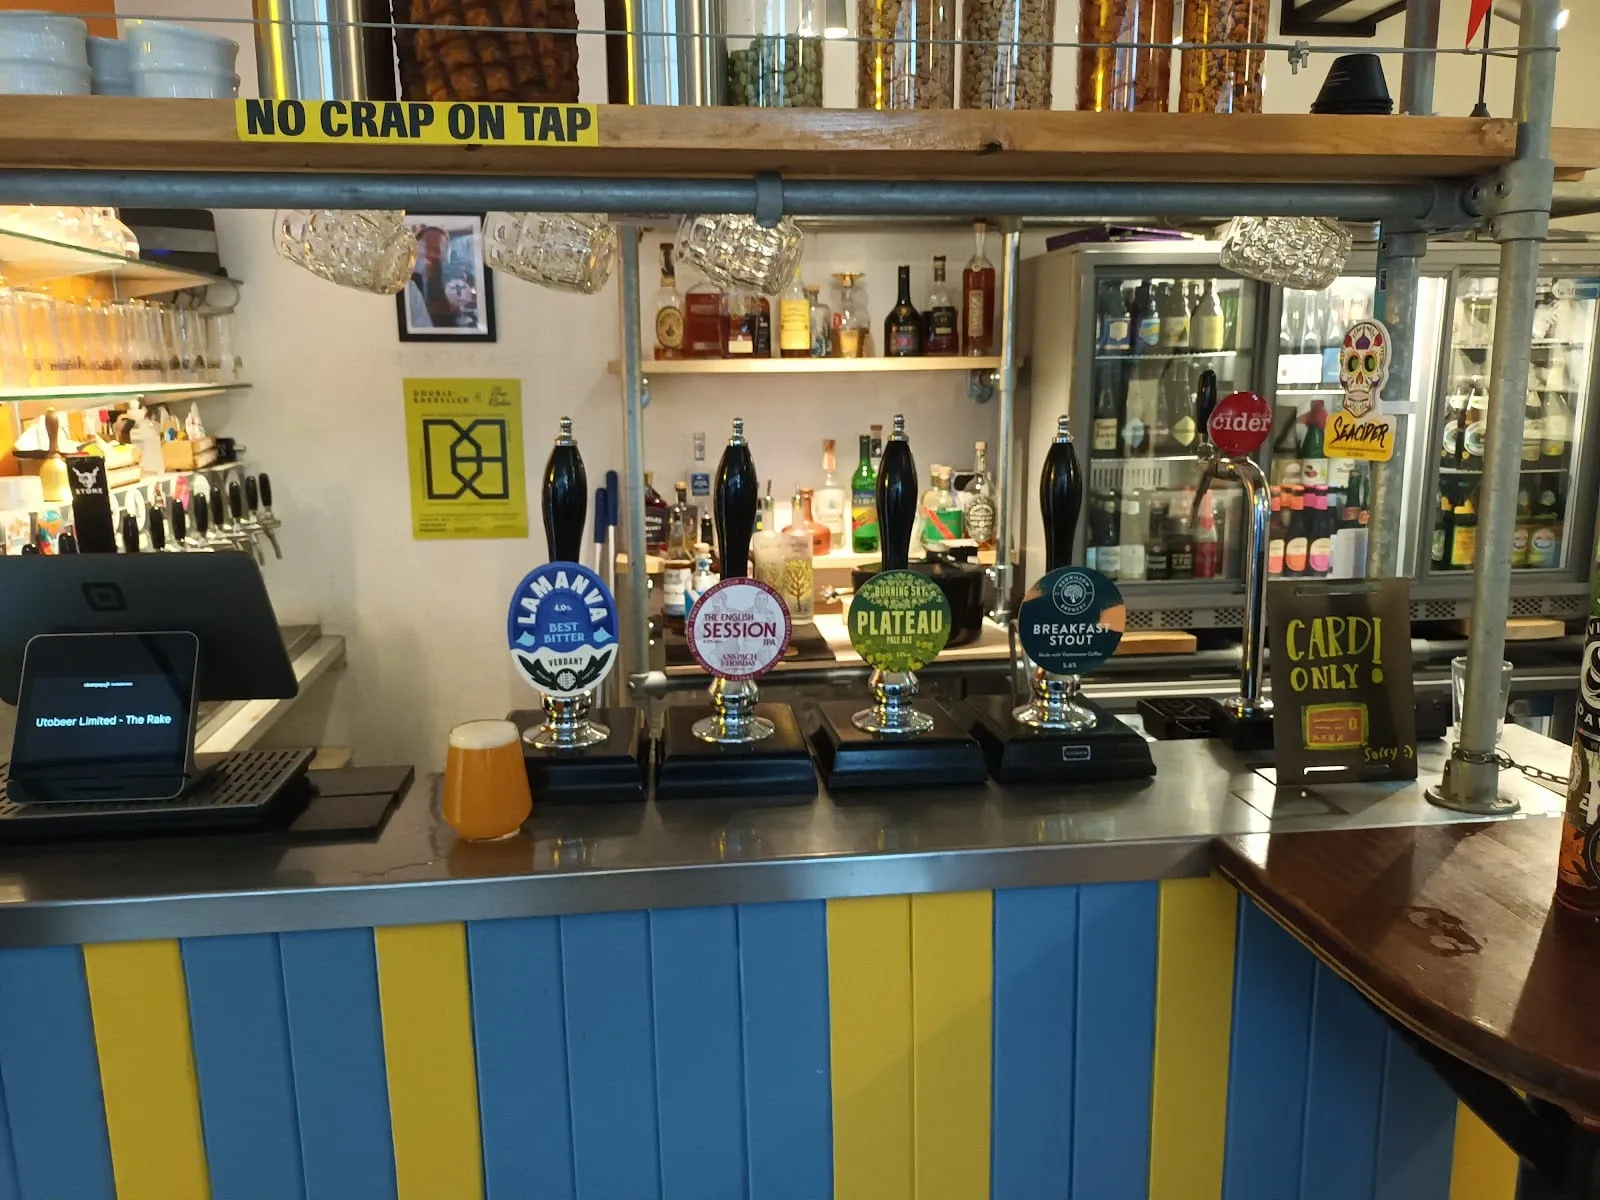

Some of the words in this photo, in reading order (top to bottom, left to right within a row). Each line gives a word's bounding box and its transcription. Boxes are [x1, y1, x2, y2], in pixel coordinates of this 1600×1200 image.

[246, 99, 306, 136] NO
[320, 101, 434, 138] CRAP
[450, 103, 505, 140] ON
[517, 106, 592, 142] TAP
[1212, 409, 1271, 432] cider
[517, 570, 609, 625] LAMANVA
[875, 585, 909, 598] BURNING
[911, 585, 926, 597] SKY
[704, 613, 718, 621] THE
[720, 613, 754, 621] ENGLISH
[857, 610, 943, 636] PLATEAU
[549, 622, 579, 633] BEST
[703, 622, 777, 638] SESSION
[1033, 623, 1111, 635] BREAKFAST
[543, 632, 585, 643] BITTER
[886, 635, 900, 644] PALE
[901, 635, 912, 644] ALE
[1049, 635, 1093, 646] STOUT
[548, 657, 583, 667] VERDANT
[1290, 663, 1359, 692] ONLY
[35, 716, 77, 727] Utobeer
[78, 715, 117, 726] Limited
[125, 714, 145, 725] The
[146, 713, 172, 725] Rake
[1364, 746, 1398, 762] Sorry
